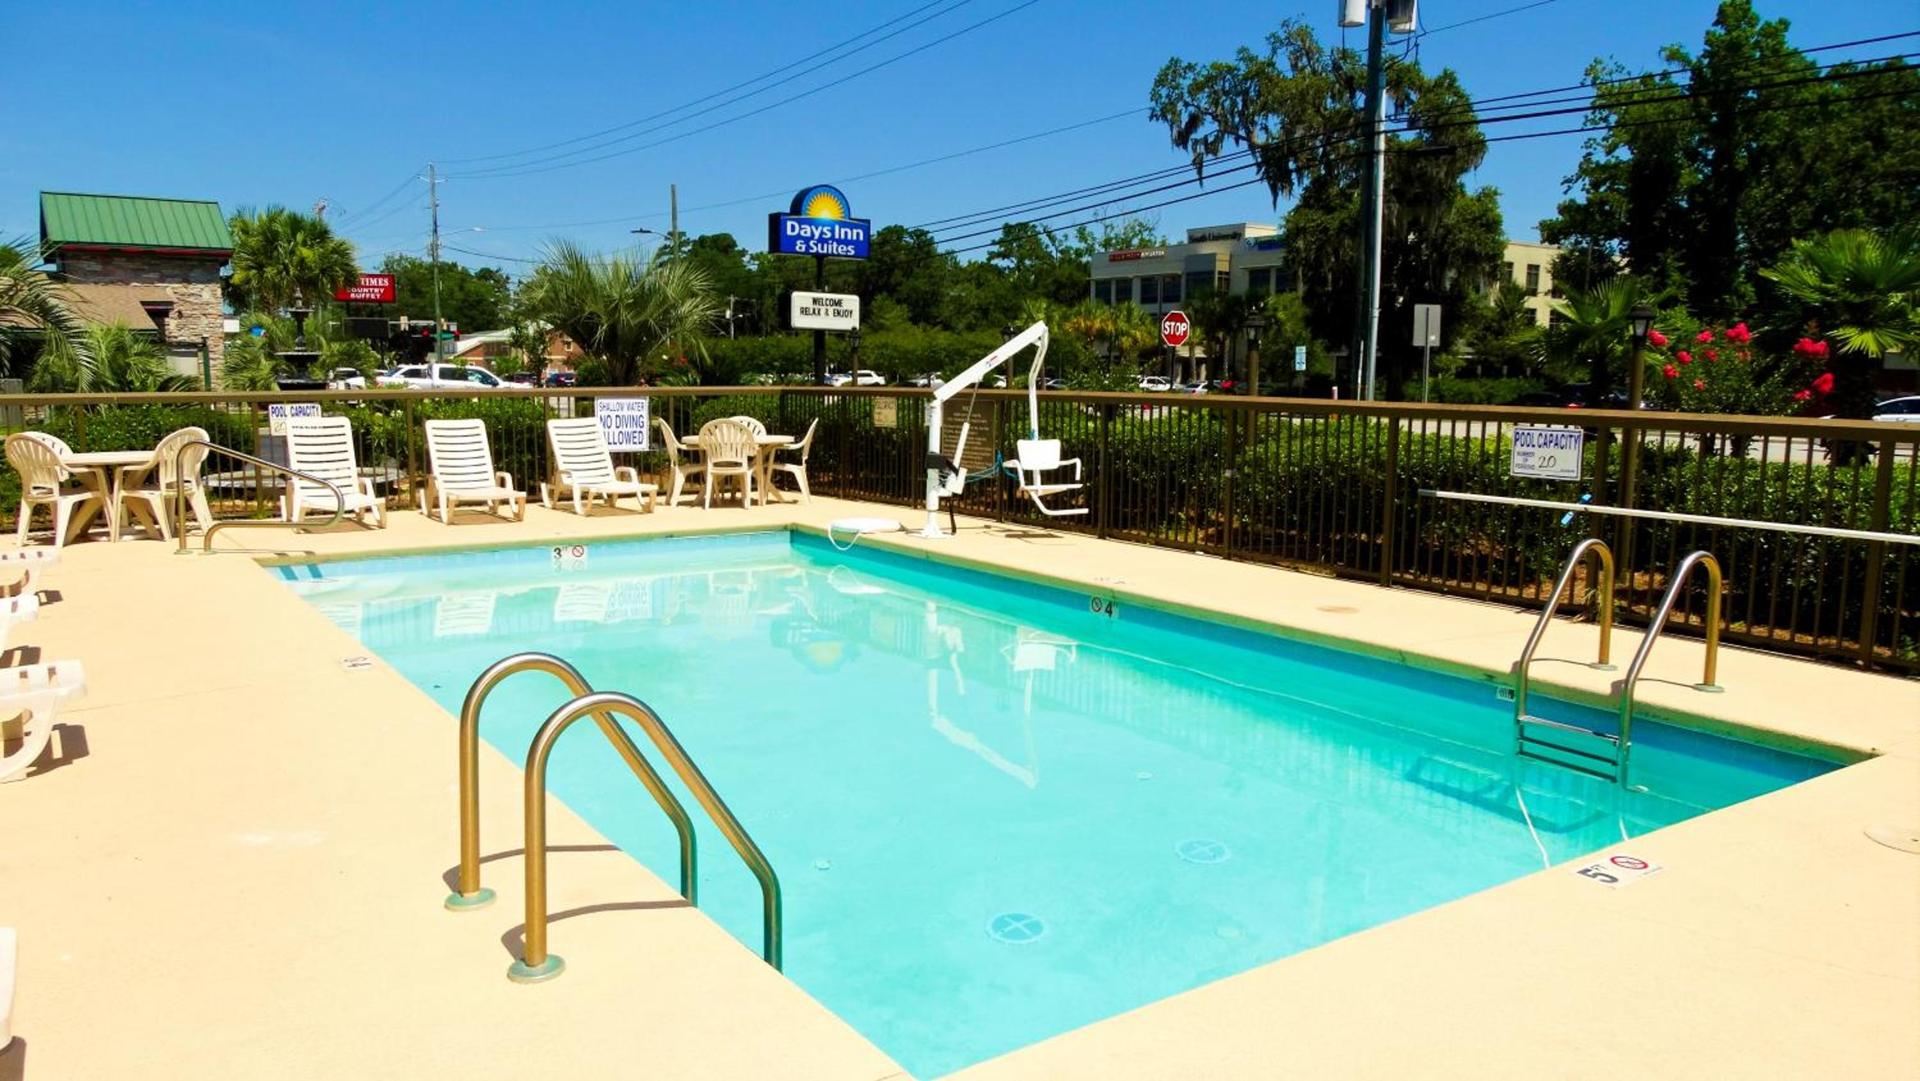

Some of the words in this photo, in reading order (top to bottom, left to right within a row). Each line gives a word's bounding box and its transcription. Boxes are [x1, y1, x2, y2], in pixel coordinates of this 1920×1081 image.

[786, 220, 832, 240] Days
[834, 224, 864, 241] Inn
[795, 240, 806, 252] &
[809, 240, 855, 256] Suites
[360, 277, 389, 287] TIMES
[812, 297, 843, 307] WELCOME
[800, 307, 821, 316] RELAX
[833, 309, 853, 319] ENJOY
[1163, 320, 1188, 337] STOP
[271, 406, 288, 418] POOL
[626, 401, 645, 412] WATER
[615, 414, 645, 429] DIVING
[1514, 431, 1536, 449] POOL
[1537, 432, 1581, 451] CAPACITY
[1538, 455, 1556, 469] 20
